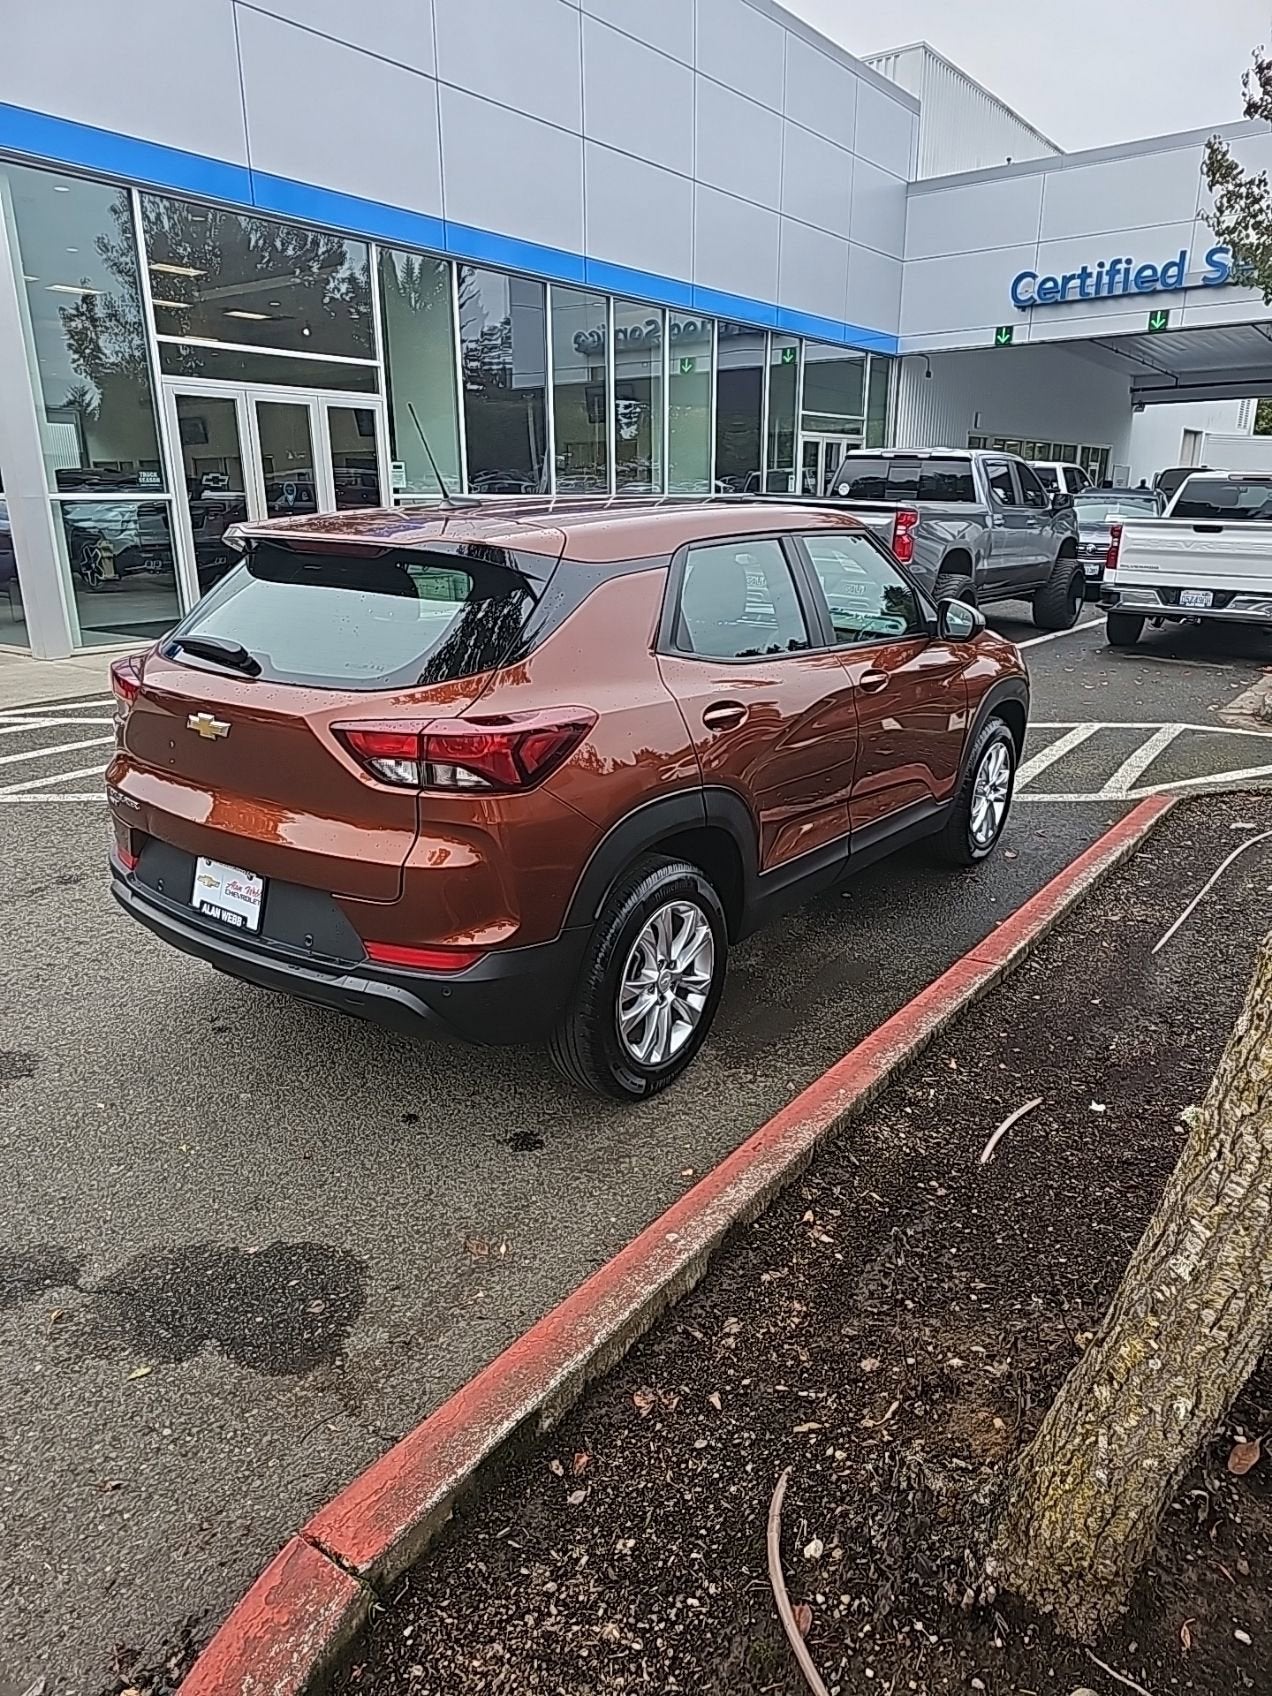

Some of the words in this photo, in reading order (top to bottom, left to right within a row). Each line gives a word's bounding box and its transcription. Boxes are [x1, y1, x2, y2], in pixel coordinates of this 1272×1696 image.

[1010, 249, 1188, 306] Certified
[224, 889, 262, 906] CHEVROLET
[201, 903, 221, 919] ALAN
[221, 909, 243, 927] WEBB
